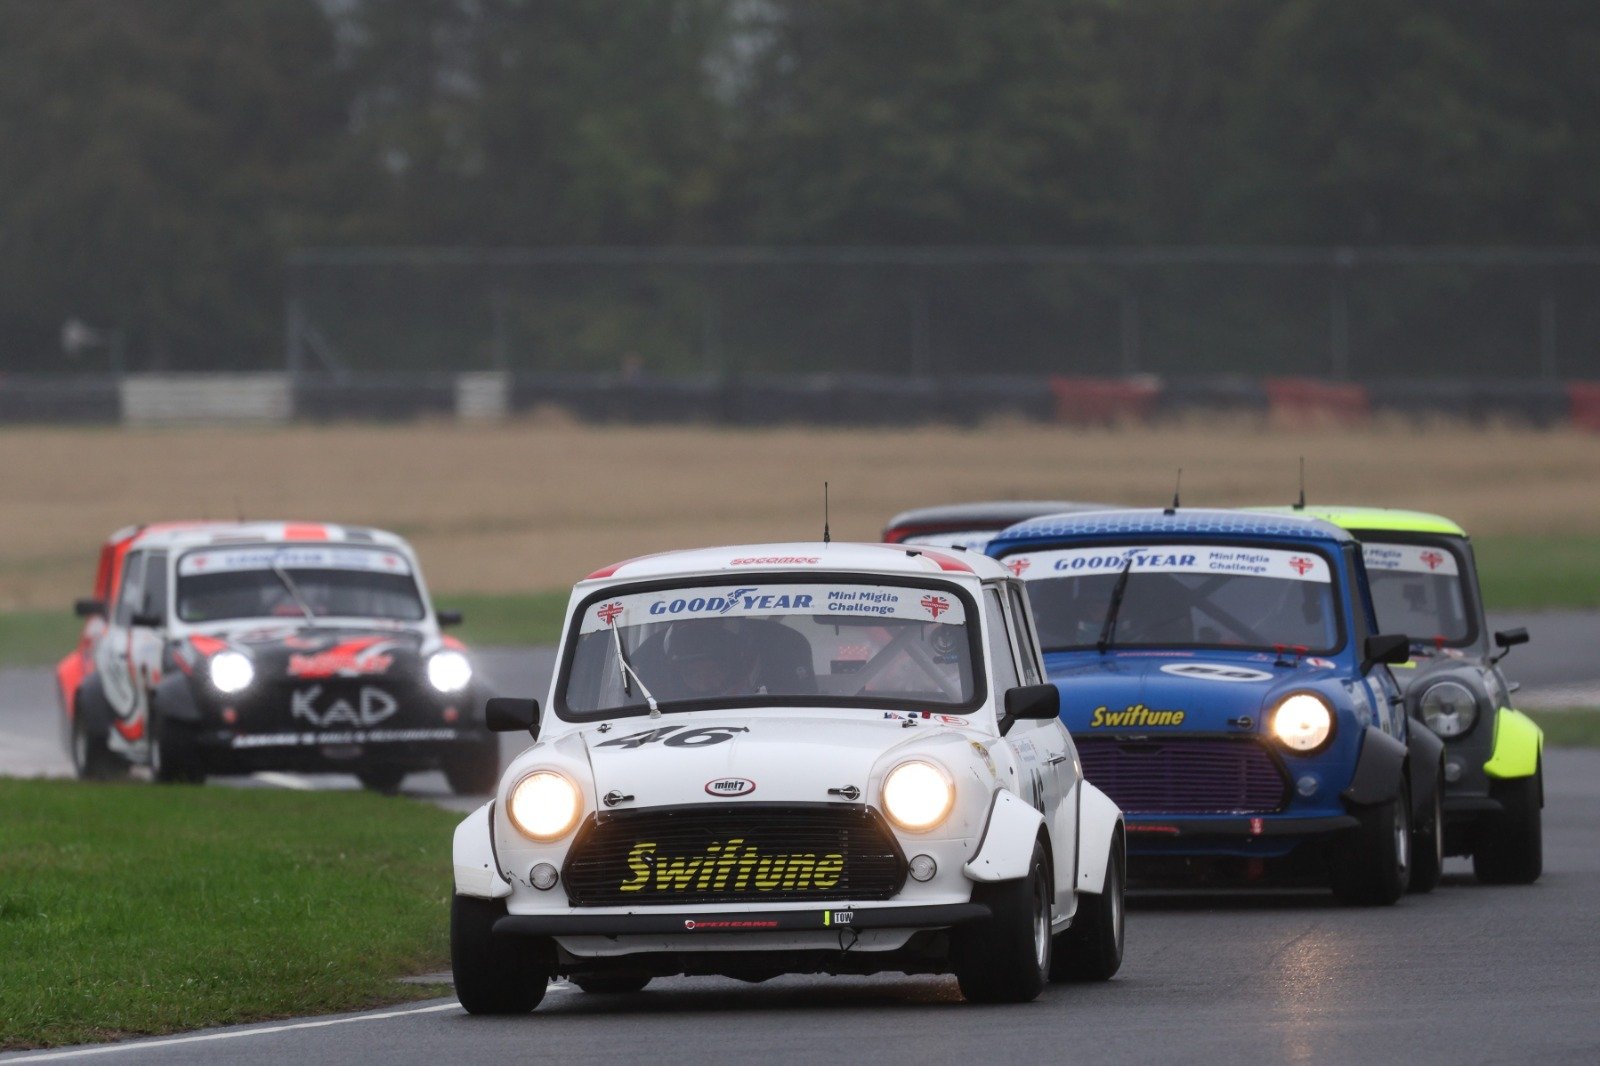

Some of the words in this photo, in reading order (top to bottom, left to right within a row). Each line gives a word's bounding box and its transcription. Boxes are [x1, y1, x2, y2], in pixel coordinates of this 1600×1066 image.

[1209, 552, 1233, 560] Mini
[1236, 554, 1270, 563] Miglia
[1209, 562, 1267, 573] Challenge
[649, 594, 814, 615] GOODYEAR
[828, 591, 856, 600] Mini
[859, 592, 899, 603] Miglia
[828, 602, 895, 614] Challenge
[291, 684, 398, 728] KAD
[1091, 704, 1185, 727] Swiftune
[593, 725, 750, 749] 46
[619, 838, 844, 892] Swiftune
[835, 912, 852, 923] TOW
